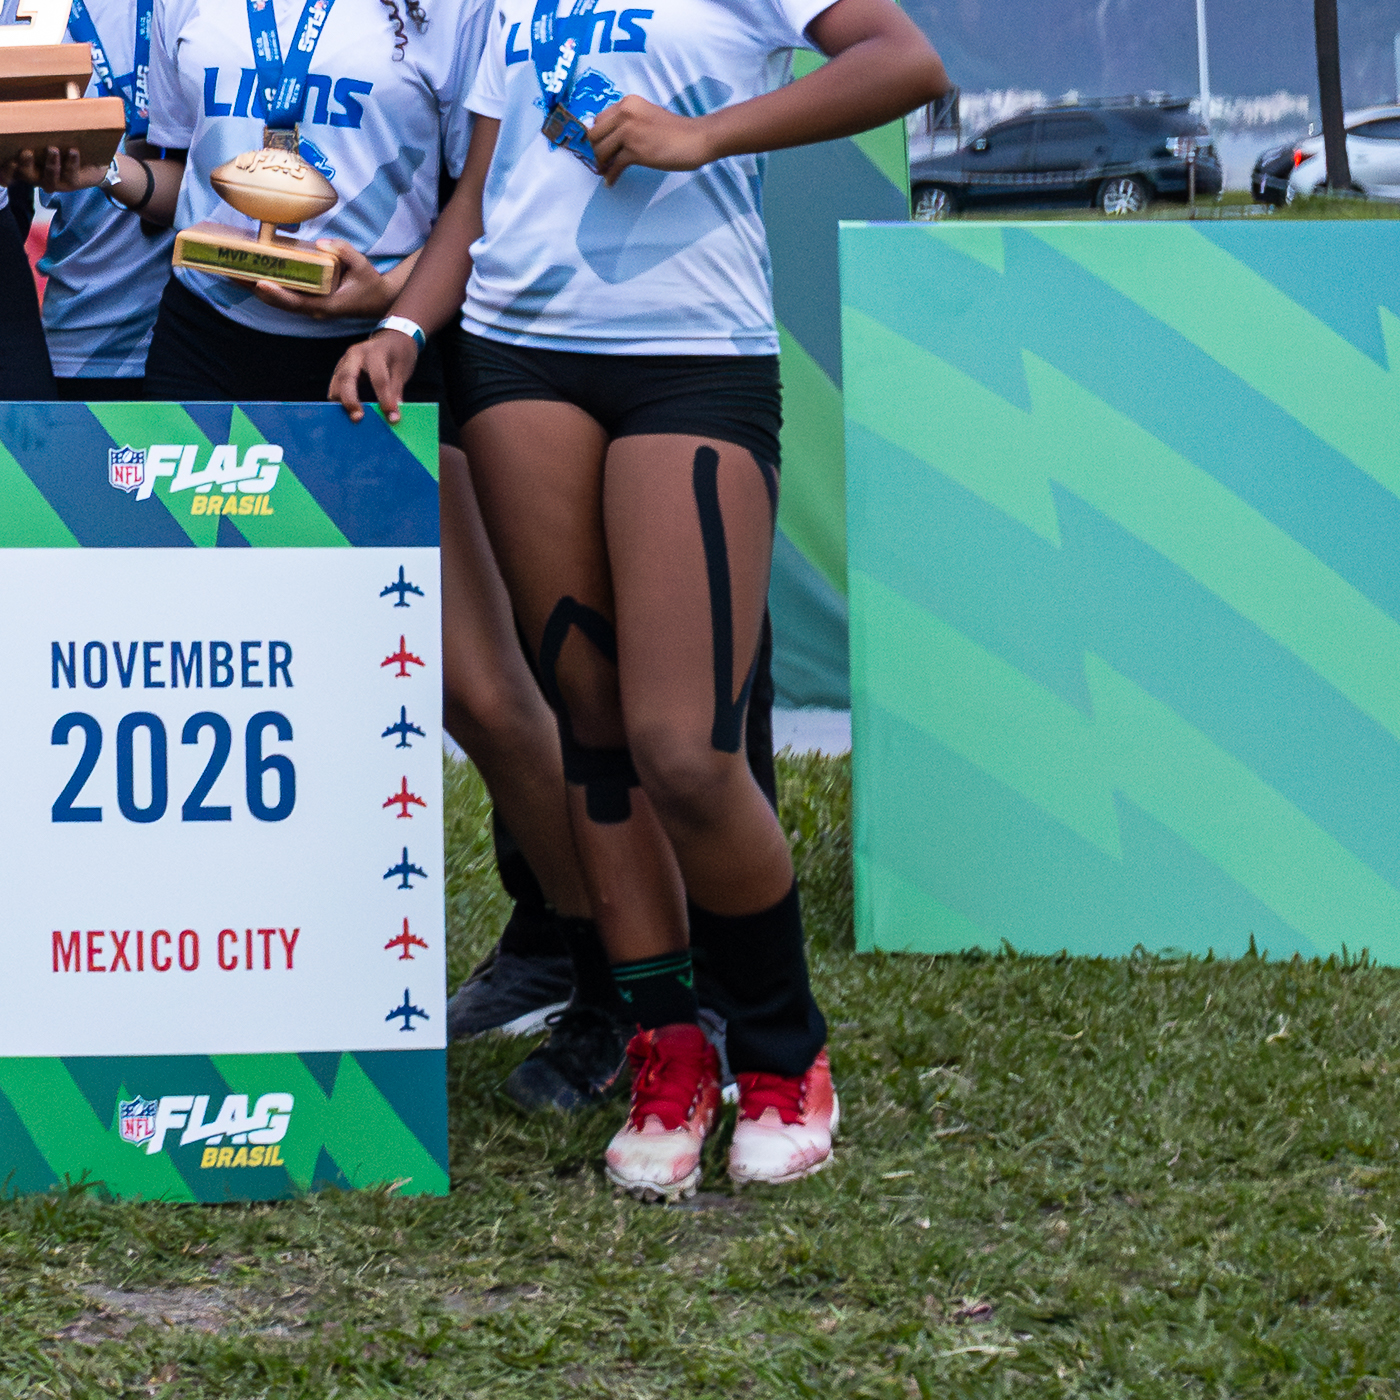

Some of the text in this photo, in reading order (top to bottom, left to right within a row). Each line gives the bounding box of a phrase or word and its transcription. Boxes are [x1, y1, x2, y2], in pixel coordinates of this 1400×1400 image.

[298, 4, 327, 52] FLAG
[218, 247, 248, 262] MVP
[112, 444, 284, 501] NFL FLAG
[190, 494, 274, 515] BRASIL
[51, 640, 294, 689] NOVEMBER
[50, 710, 296, 824] 2026
[51, 928, 301, 973] MEXICO CITY
[146, 1093, 294, 1155] FLAG
[200, 1145, 285, 1168] BRASIL
